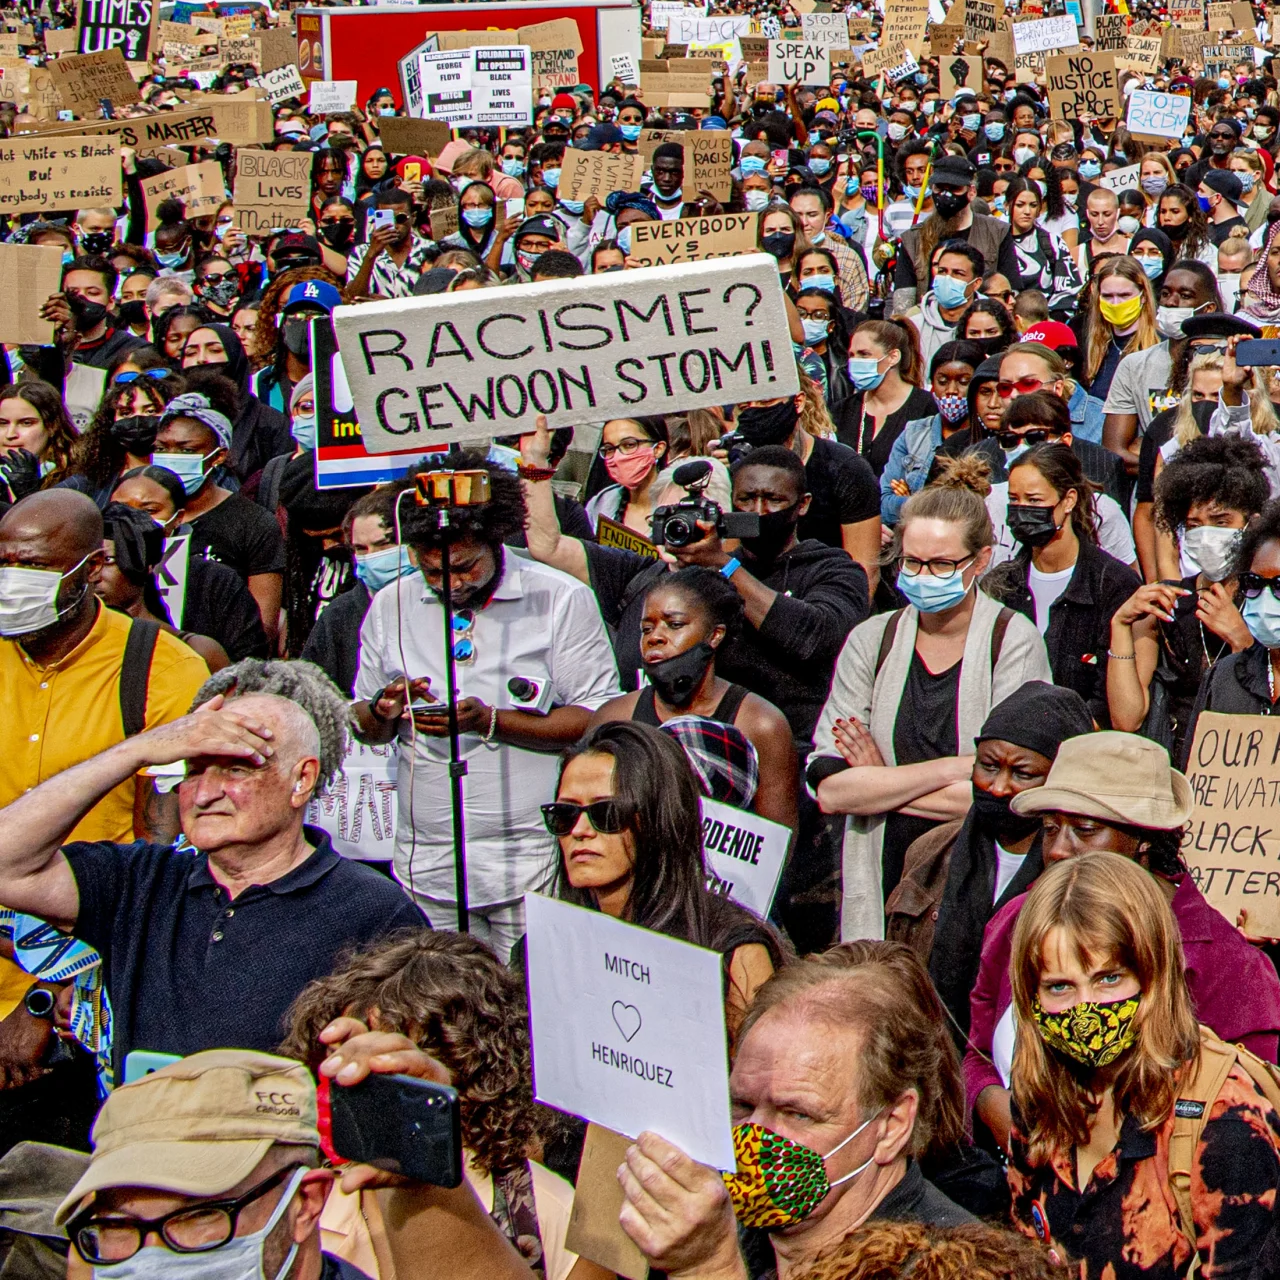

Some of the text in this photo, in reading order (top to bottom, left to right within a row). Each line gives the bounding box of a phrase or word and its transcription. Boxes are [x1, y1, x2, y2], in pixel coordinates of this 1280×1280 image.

[807, 14, 839, 25] STOP
[1096, 15, 1126, 29] BLACK
[681, 20, 748, 42] BLACK
[804, 31, 847, 44] RACISME
[1099, 27, 1121, 37] LIVES
[1096, 35, 1127, 49] MATTER
[478, 50, 524, 59] SOLIDAIR MET
[776, 44, 825, 60] SPEAK
[479, 61, 521, 69] DE OPSTAND
[784, 63, 816, 81] UP
[1069, 57, 1093, 70] NO
[440, 73, 460, 81] FLOYD
[490, 73, 512, 81] BLACK
[1050, 73, 1113, 91] JUSTICE
[492, 89, 511, 97] LIVES
[1076, 91, 1096, 103] NO
[1062, 101, 1114, 120] PEACE
[1131, 93, 1185, 112] STOP
[1130, 110, 1187, 131] RACISM
[146, 117, 217, 142] MATTER
[23, 144, 115, 160] White Black
[240, 155, 309, 179] BLACK
[258, 182, 302, 199] LIVES
[636, 216, 749, 242] EVERYBODY
[666, 241, 699, 252] VS
[359, 283, 762, 375] RACISME?
[376, 339, 776, 436] GEWOON STOM!
[1198, 729, 1262, 768] OUR
[1190, 774, 1219, 807] ARE
[1183, 820, 1272, 856] BLACK
[604, 952, 651, 984] MITCH
[591, 1041, 674, 1089] HENRIQUEZ
[256, 1090, 295, 1106] FCC
